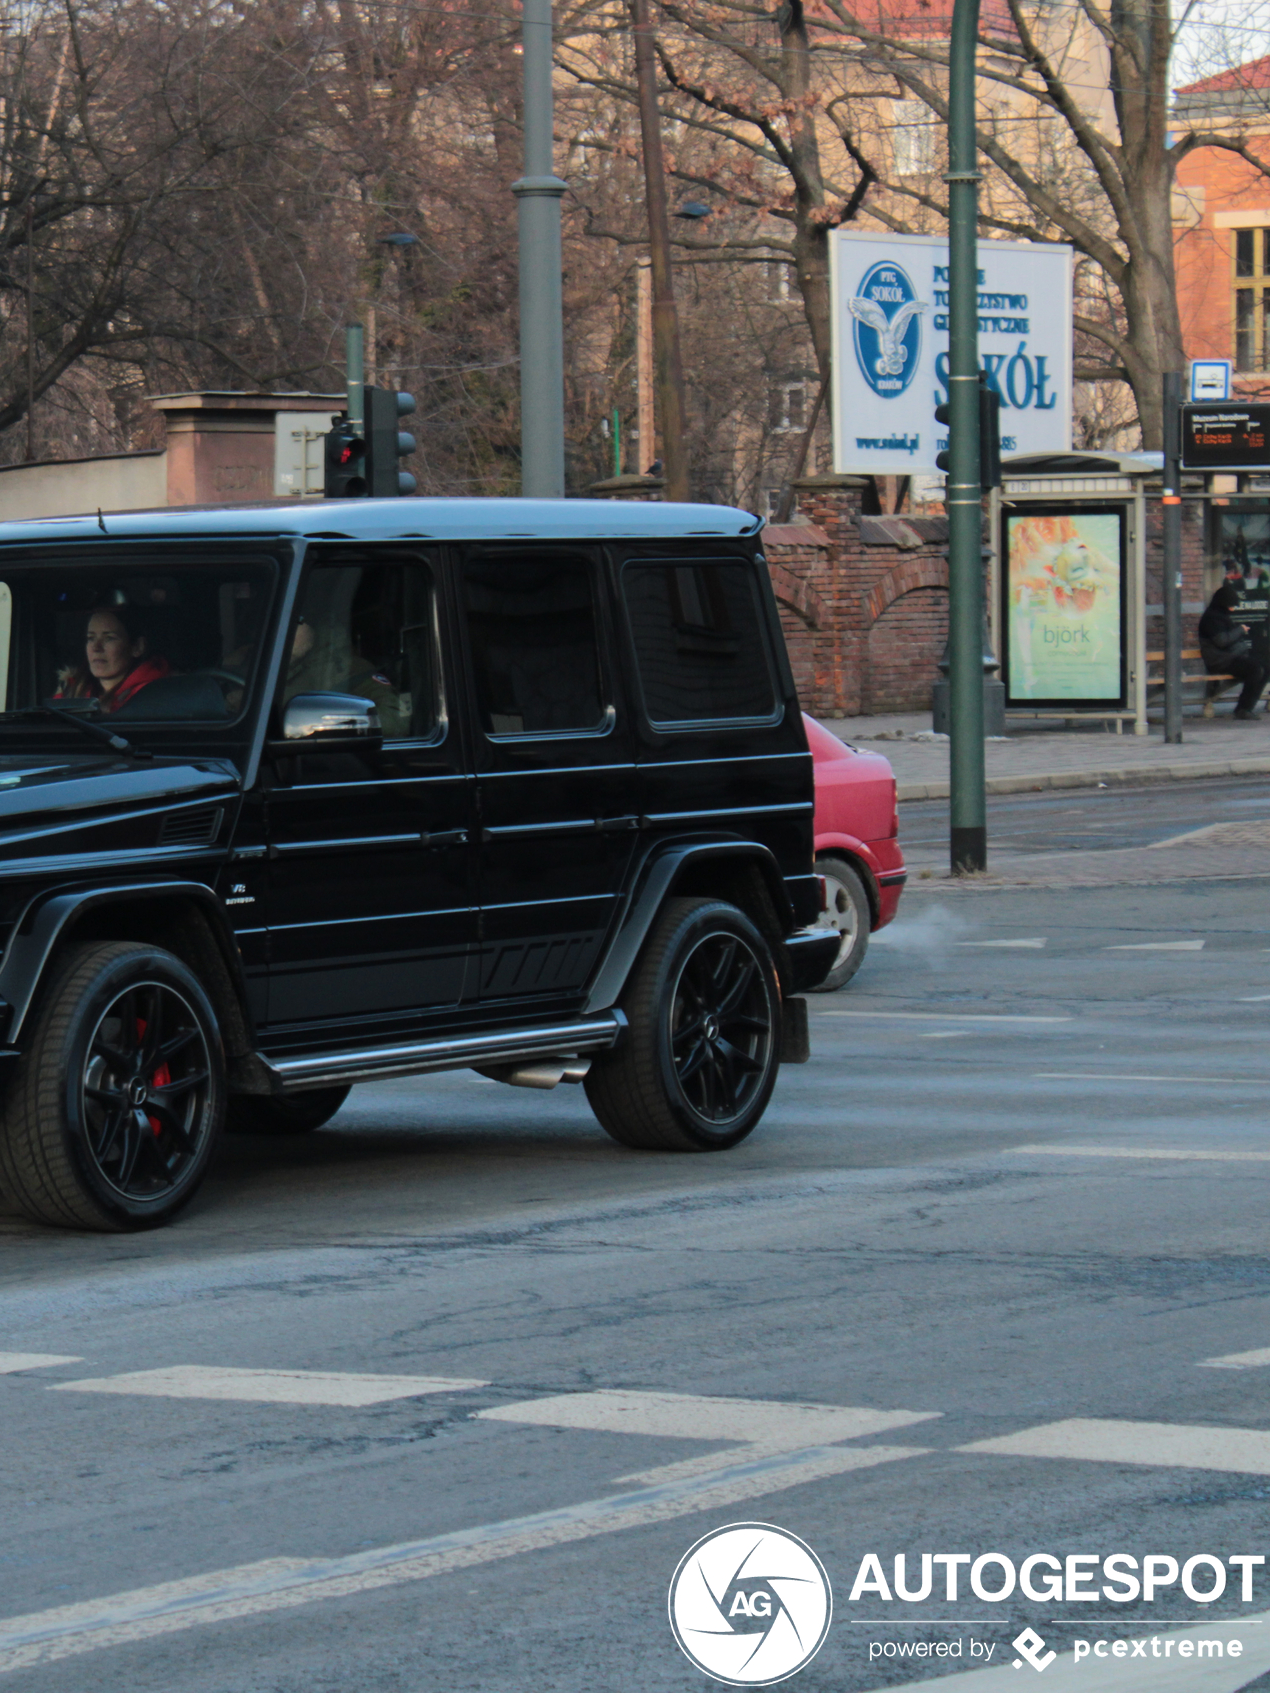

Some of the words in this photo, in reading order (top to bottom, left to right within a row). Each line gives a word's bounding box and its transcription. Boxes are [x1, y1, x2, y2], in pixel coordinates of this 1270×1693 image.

[871, 283, 906, 303] SOKÓŁ
[934, 341, 1057, 410] SKÓŁ
[1043, 624, 1091, 648] björk
